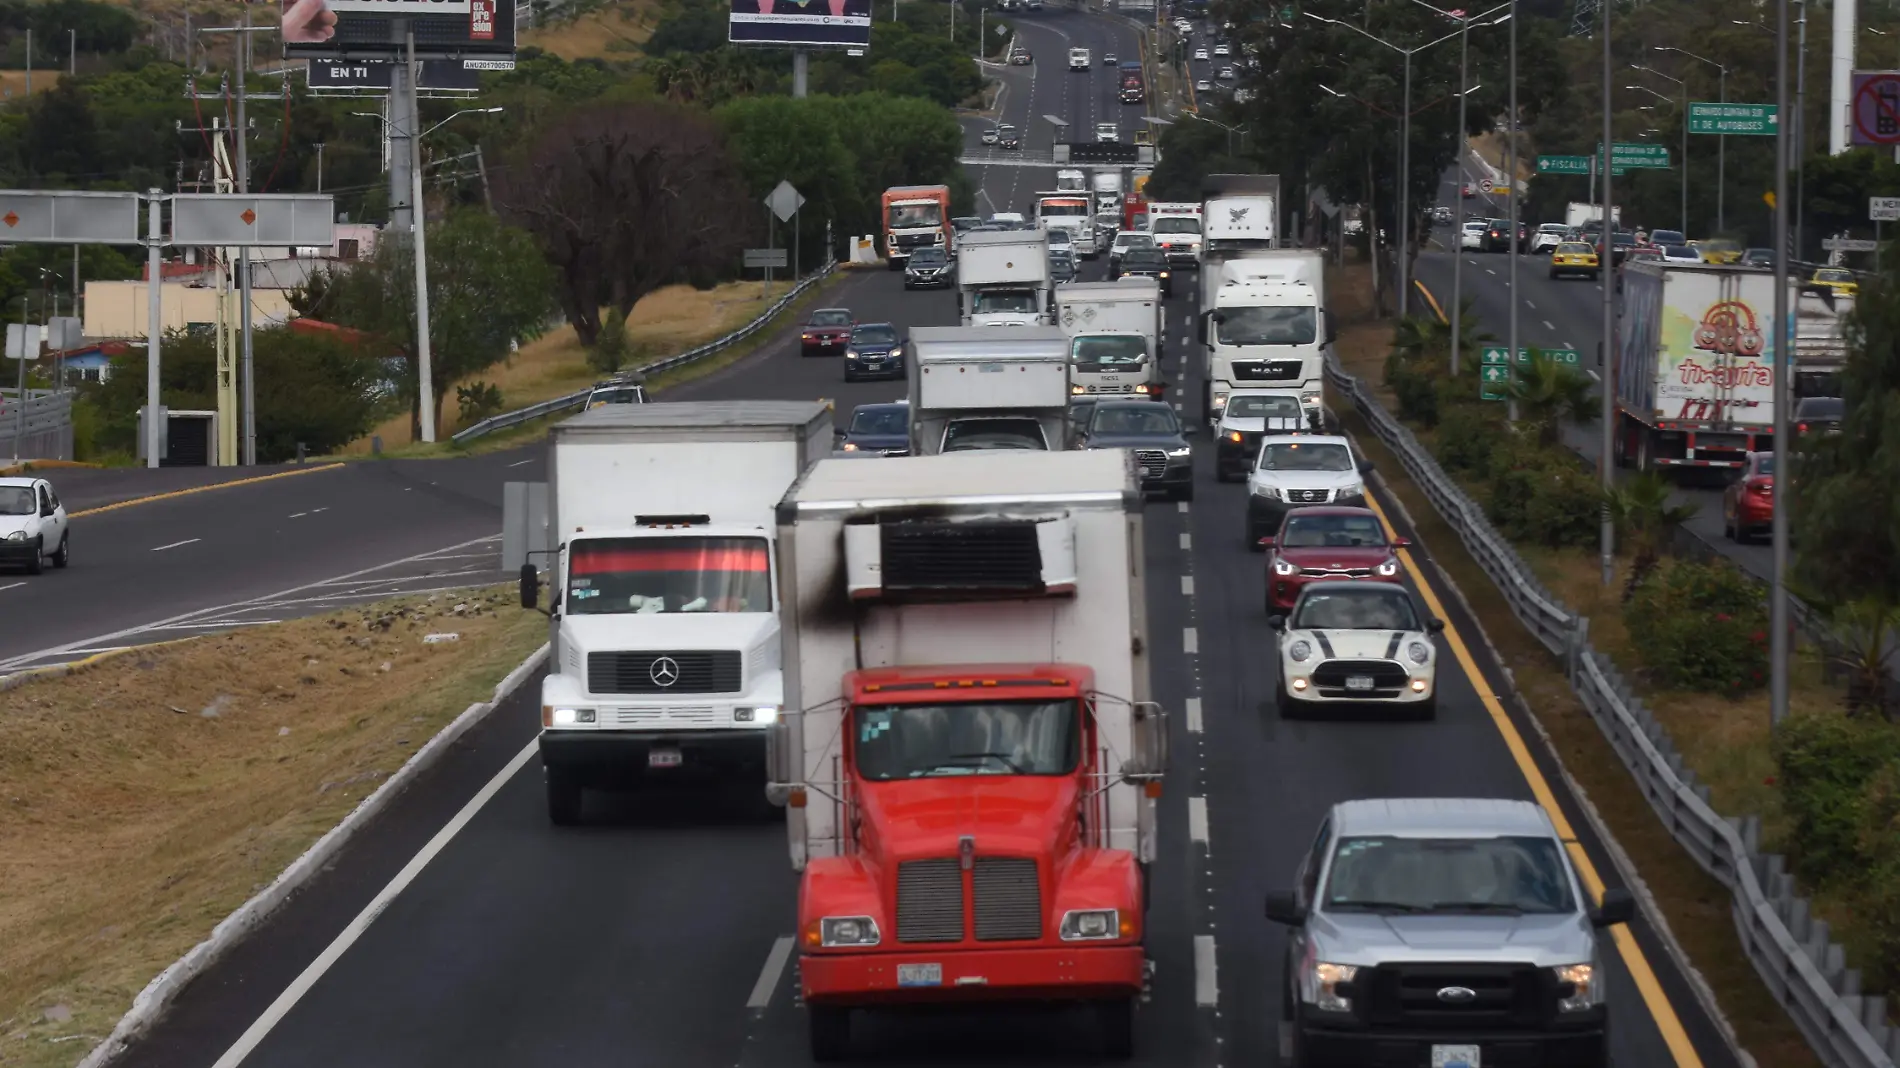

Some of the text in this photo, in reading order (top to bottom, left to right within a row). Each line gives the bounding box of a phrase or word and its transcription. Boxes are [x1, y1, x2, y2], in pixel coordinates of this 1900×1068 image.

[473, 2, 485, 11] ex
[473, 11, 489, 22] pre
[330, 67, 368, 78] EN TI
